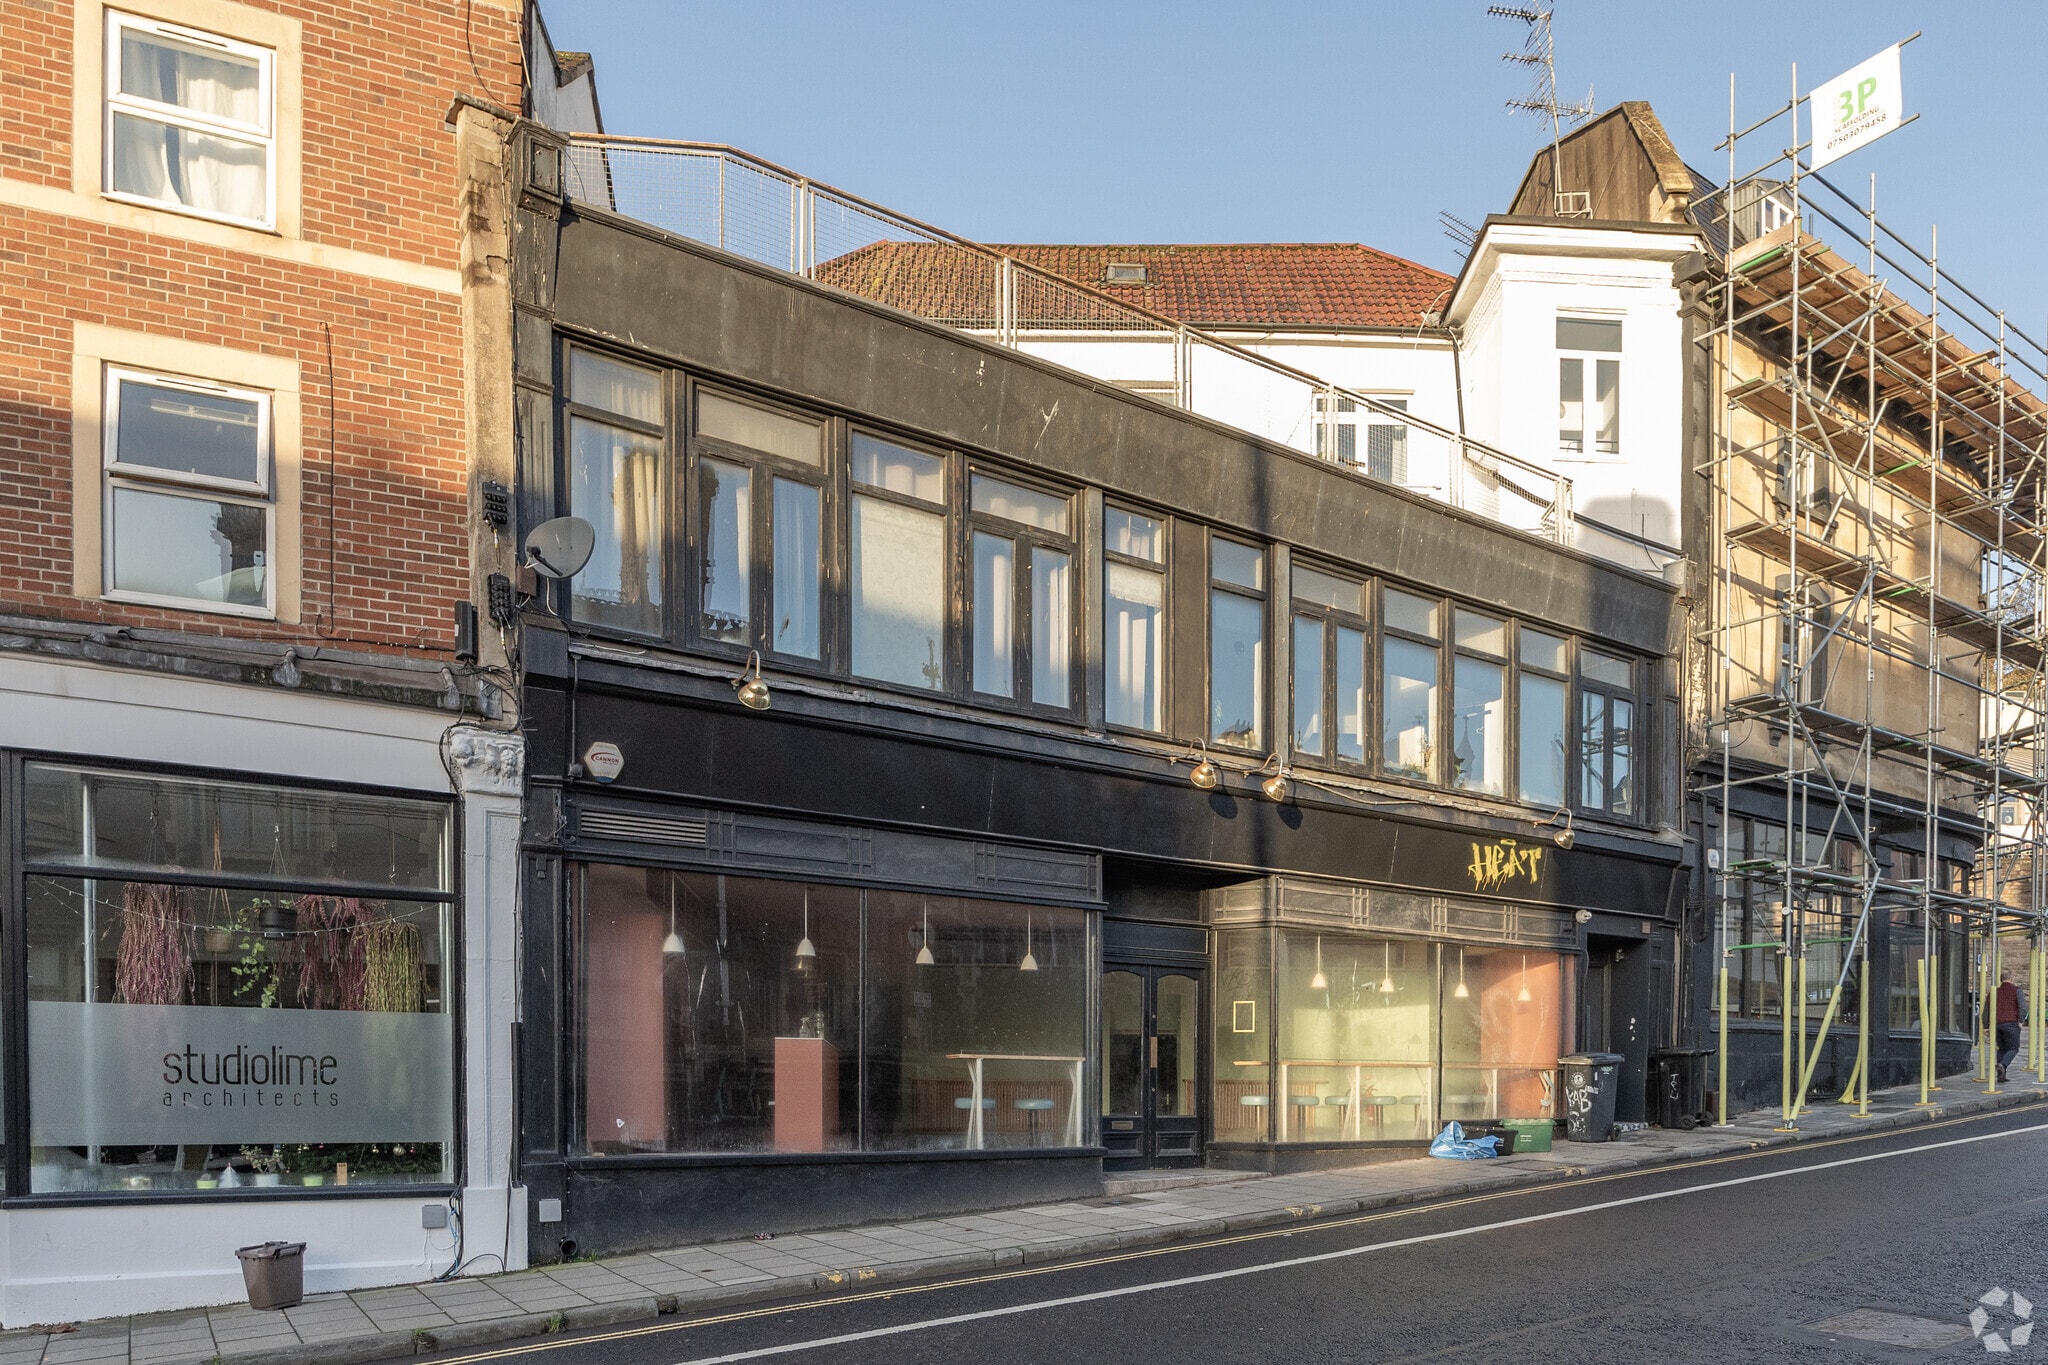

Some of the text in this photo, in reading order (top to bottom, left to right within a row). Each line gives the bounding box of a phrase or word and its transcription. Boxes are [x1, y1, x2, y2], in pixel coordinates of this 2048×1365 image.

[1827, 113, 1887, 150] 07503079458
[1834, 105, 1880, 133] SCAFFOLDING
[163, 1044, 338, 1085] studiolime
[163, 1088, 339, 1106] architects
